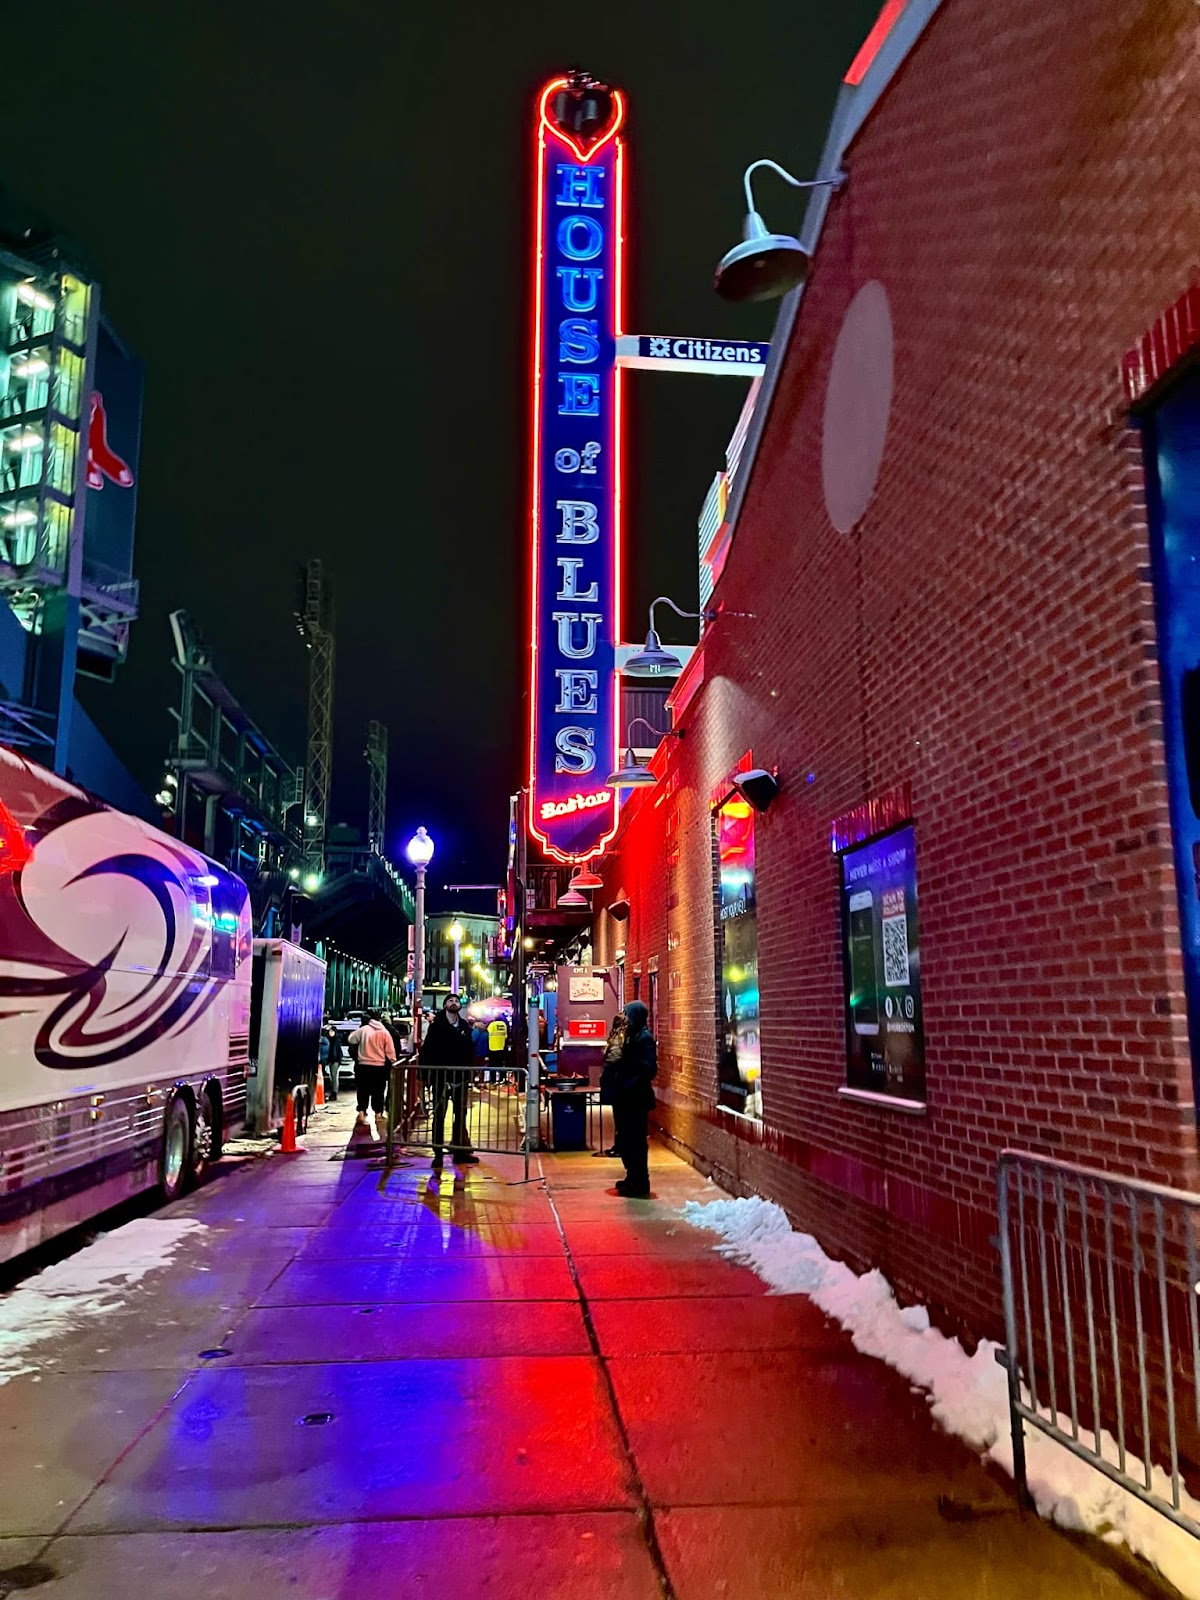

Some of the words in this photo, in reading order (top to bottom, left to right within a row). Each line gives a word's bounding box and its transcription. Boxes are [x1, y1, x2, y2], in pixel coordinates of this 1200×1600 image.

[556, 163, 605, 417] HOUSE
[673, 339, 762, 363] Citizens
[554, 441, 602, 475] of
[552, 500, 603, 775] BLUES
[540, 790, 612, 820] Boston
